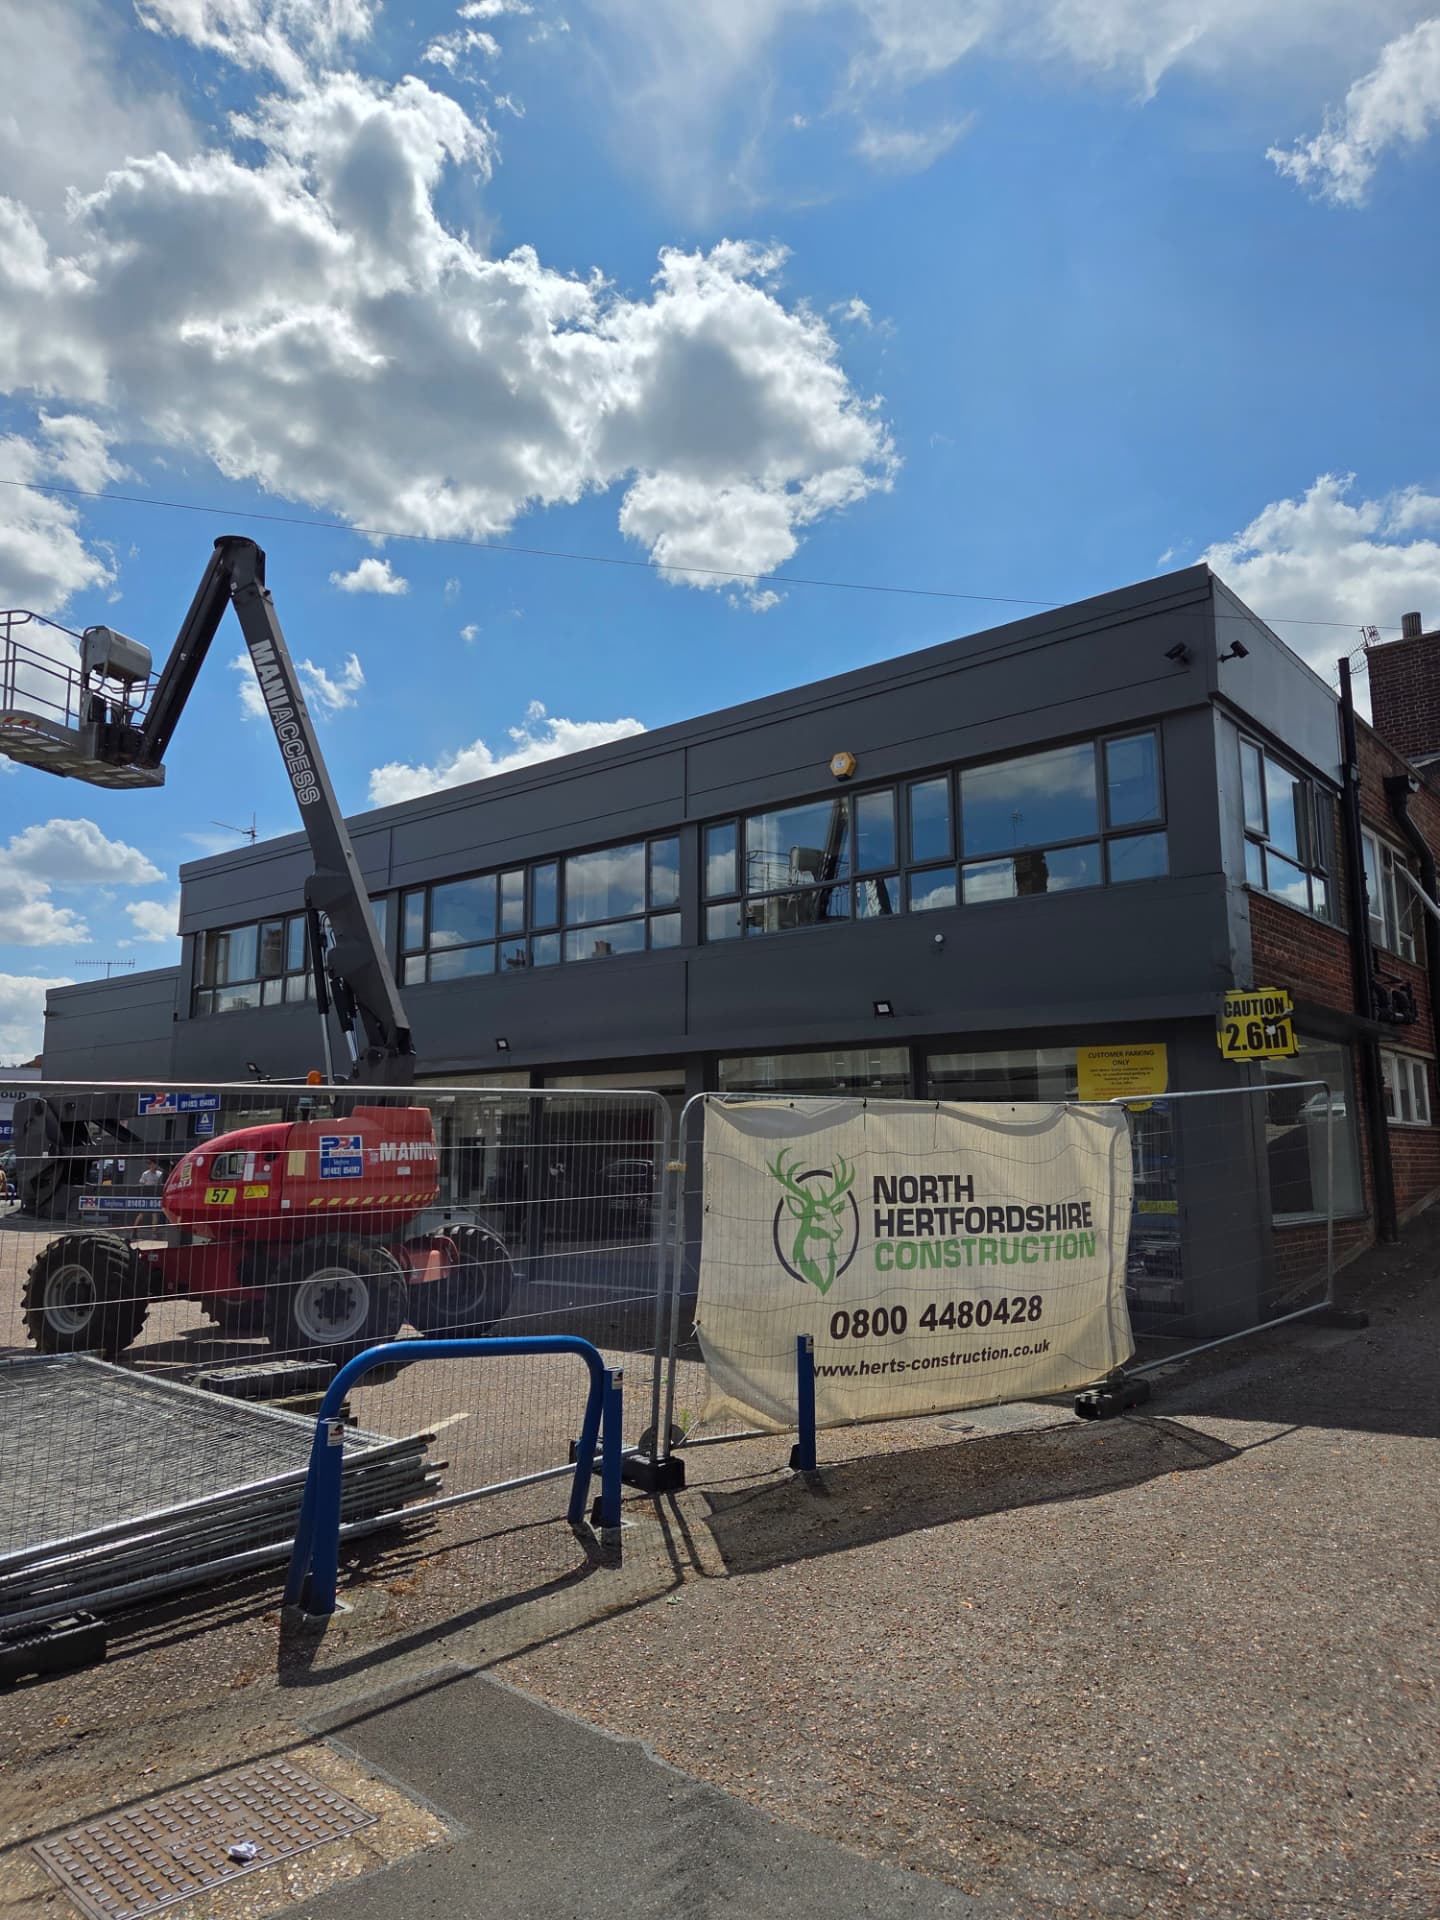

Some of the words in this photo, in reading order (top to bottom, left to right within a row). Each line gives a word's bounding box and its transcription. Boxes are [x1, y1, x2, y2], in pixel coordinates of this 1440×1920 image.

[251, 639, 320, 805] MANIACCESS
[1224, 997, 1284, 1018] CAUTION
[1225, 1022, 1289, 1052] 2.6m
[1088, 1050, 1123, 1059] CUSTOMER
[1125, 1049, 1155, 1057] PARKING
[211, 1188, 230, 1203] 57
[873, 1175, 975, 1204] NORTH
[874, 1201, 1093, 1238] HERTFORDSHIRE
[875, 1231, 1096, 1271] CONSTRUCTION
[830, 1305, 908, 1340] 0800
[919, 1294, 1043, 1332] 4480428
